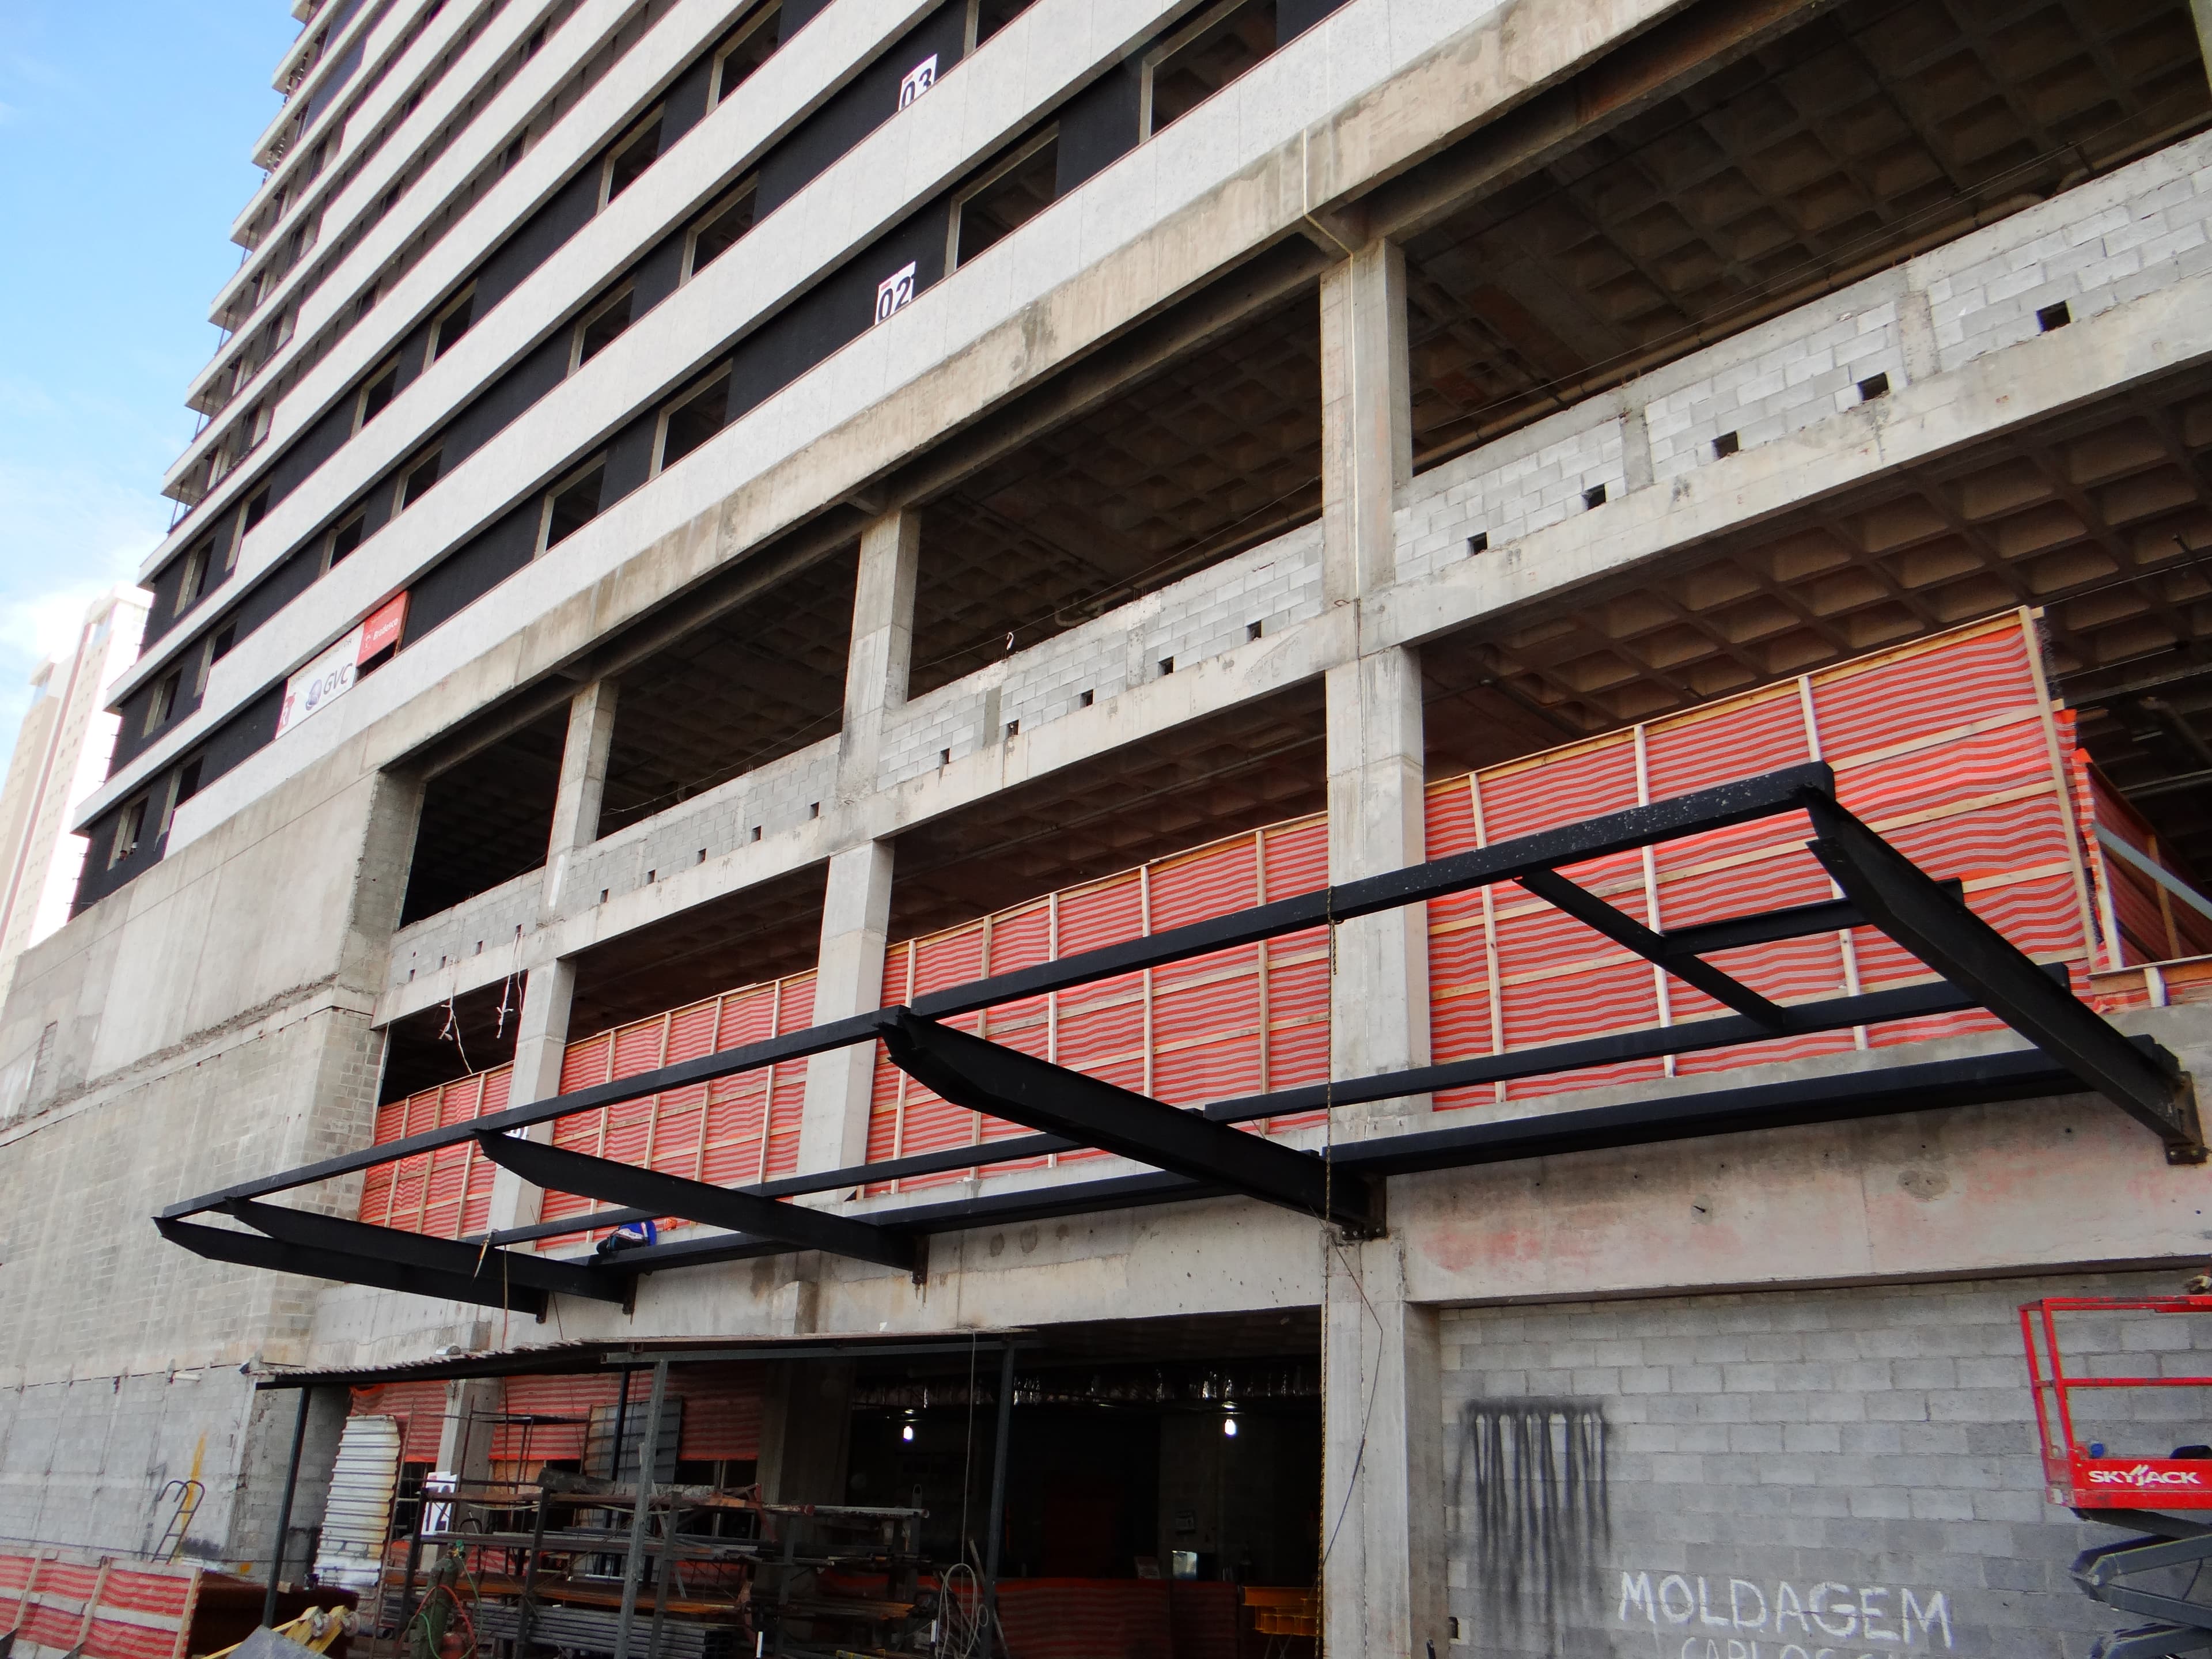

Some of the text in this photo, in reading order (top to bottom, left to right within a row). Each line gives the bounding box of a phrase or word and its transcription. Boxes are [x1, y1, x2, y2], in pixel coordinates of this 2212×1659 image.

[900, 67, 932, 108] 03
[878, 276, 911, 322] 02
[323, 662, 353, 695] GVC
[2088, 1464, 2201, 1486] SKYJACK
[1618, 1570, 1953, 1648] MOLDAGEM
